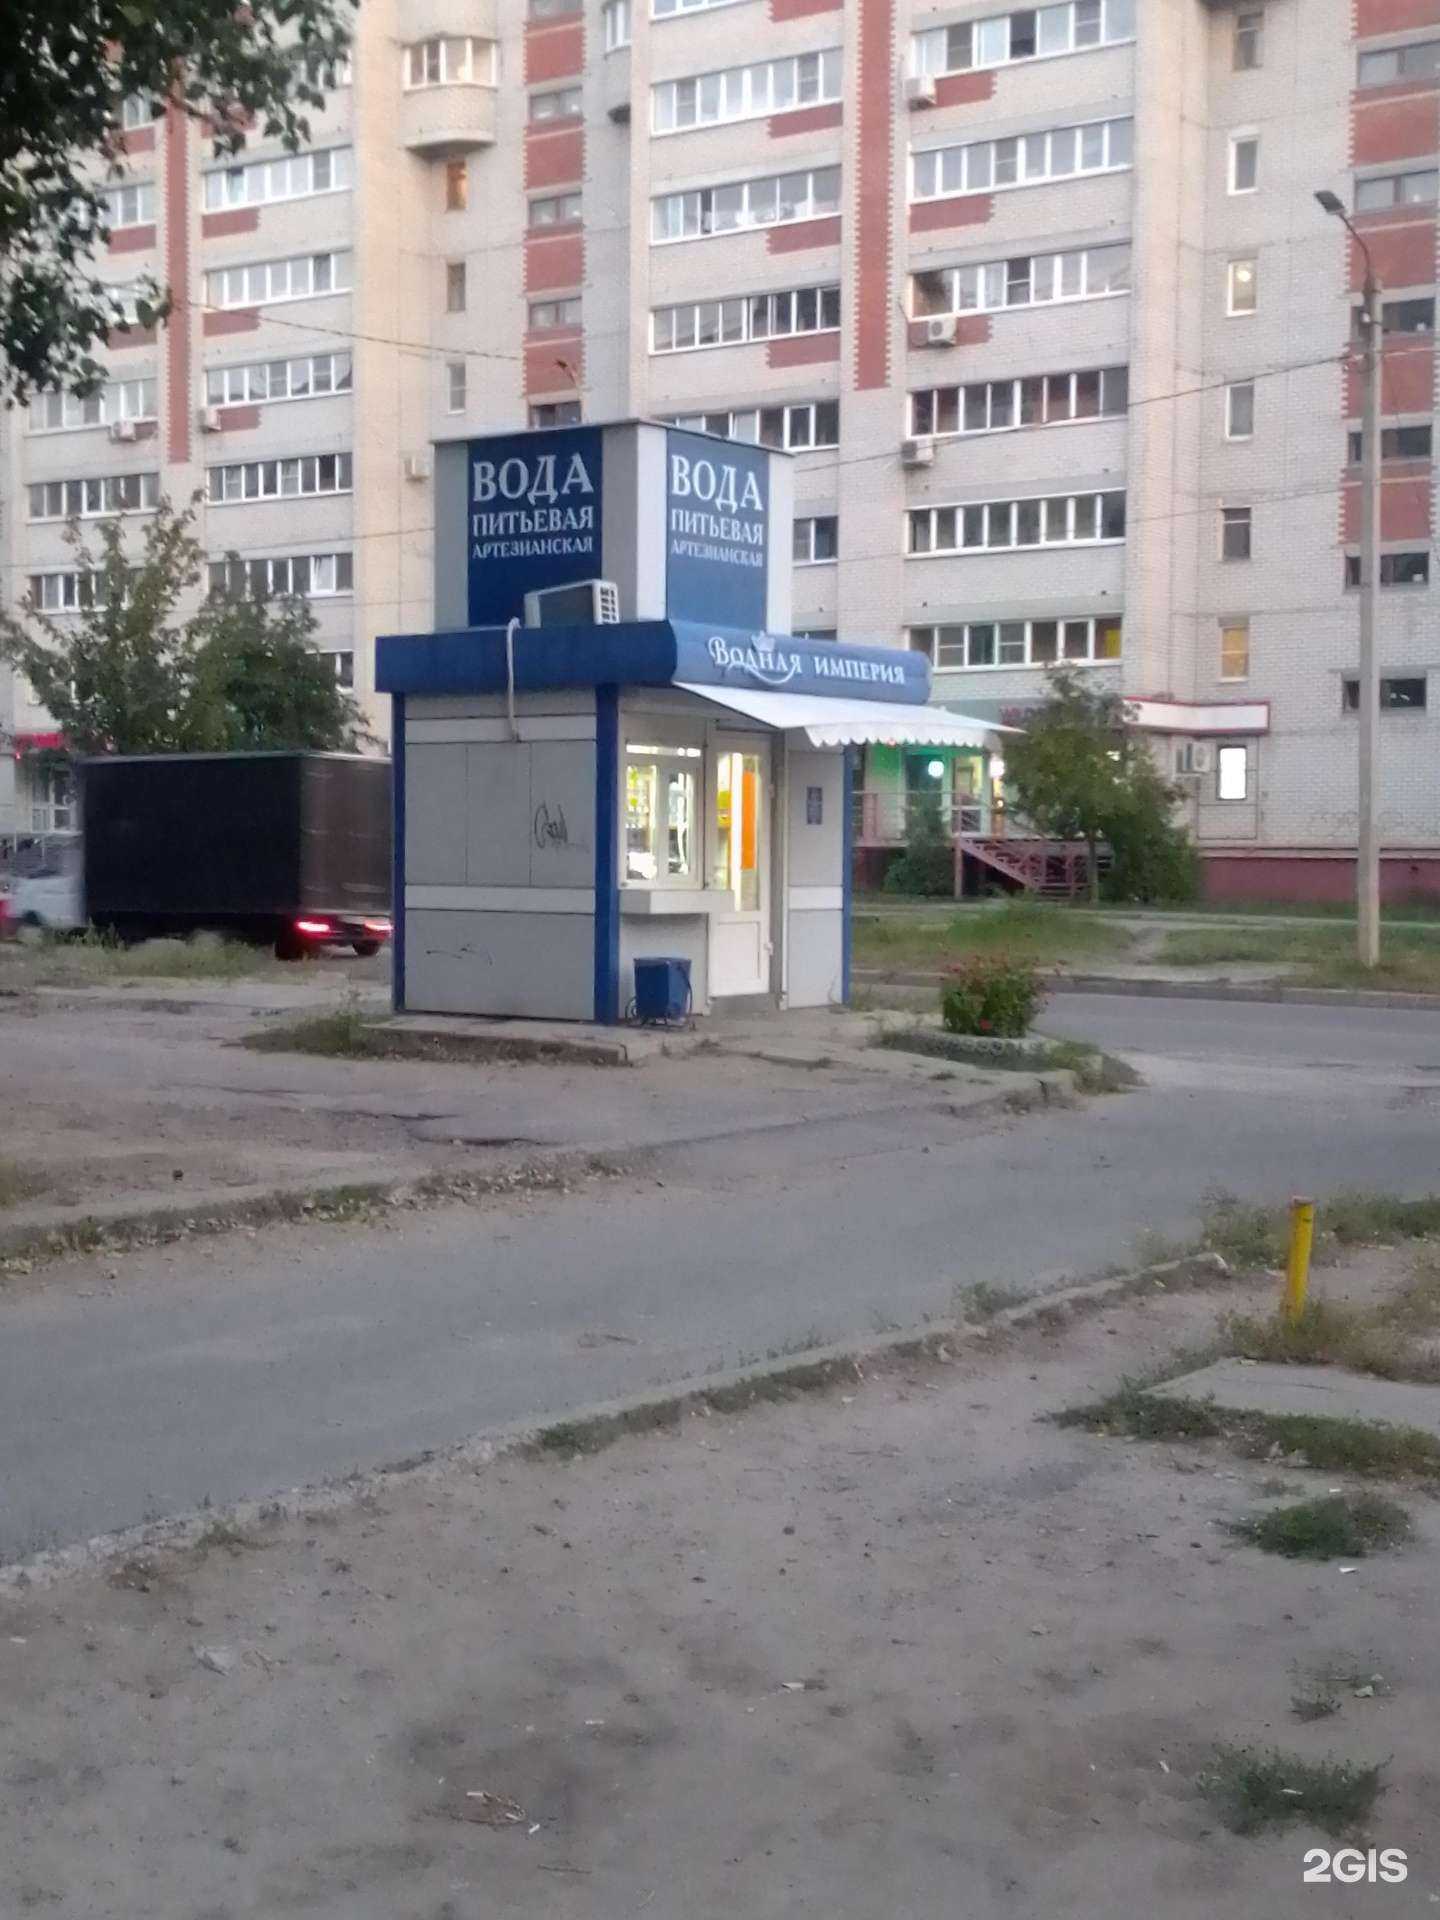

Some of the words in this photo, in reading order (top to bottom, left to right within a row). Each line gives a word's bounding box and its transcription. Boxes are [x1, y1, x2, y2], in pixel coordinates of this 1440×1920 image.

[473, 453, 595, 505] ВОДА
[671, 454, 764, 513] ВОДА
[473, 506, 594, 537] ПИТЬЕВАЯ
[671, 509, 764, 546] ПИТЬЕВАЯ
[472, 536, 593, 560] АРТЕЗИАНСКАЯ
[814, 656, 905, 685] ИМПЕРИЯ
